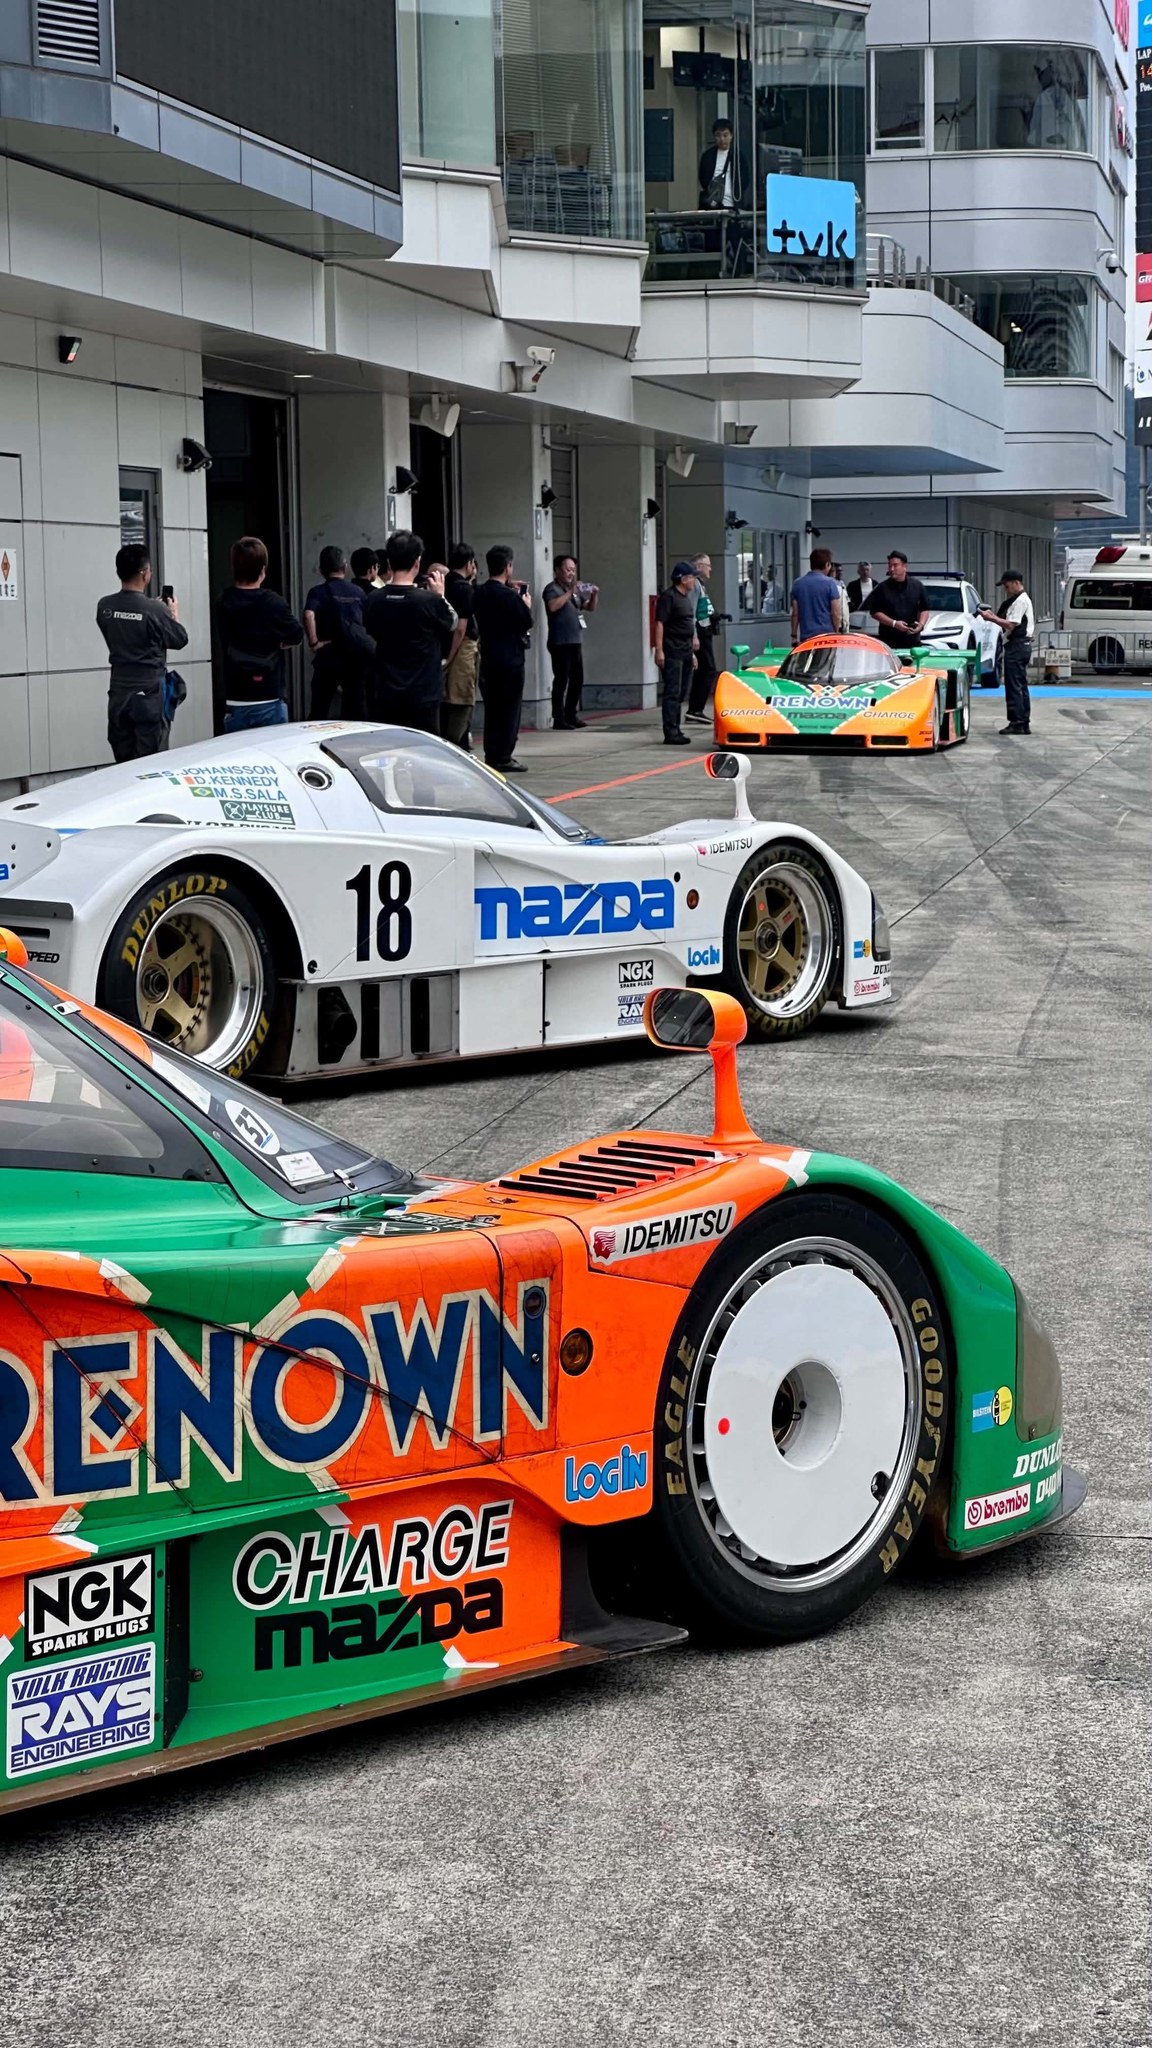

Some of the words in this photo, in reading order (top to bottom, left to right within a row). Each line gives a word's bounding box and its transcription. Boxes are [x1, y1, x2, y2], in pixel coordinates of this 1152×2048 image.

[772, 219, 848, 258] tvk
[721, 709, 773, 718] CHARGE
[770, 695, 870, 710] RENOWN
[788, 711, 848, 720] mazda
[863, 710, 916, 720] CHARGE
[162, 765, 277, 777] S.JOHANSSON
[195, 776, 279, 787] D.KENNEDY
[213, 787, 288, 801] M.S.SALA
[241, 802, 290, 814] PLAYSURE
[256, 810, 281, 820] CLUB
[710, 837, 753, 854] IDEMITSU
[121, 874, 228, 971] DUNLOP
[345, 860, 412, 962] 18
[474, 879, 675, 940] mazda
[619, 961, 653, 982] NGK
[623, 1206, 732, 1255] IDEMITSU
[665, 1335, 695, 1495] EAGLE
[984, 1490, 1029, 1520] brembo
[233, 1500, 514, 1610] CHARGE
[33, 1558, 148, 1636] NGK
[32, 1630, 89, 1657] SPARK
[94, 1616, 149, 1642] PLUGS
[254, 1577, 503, 1672] mazda
[12, 1671, 68, 1701] VOLK
[70, 1652, 151, 1689] RACING
[11, 1676, 151, 1746] RAYS
[11, 1720, 150, 1768] ENGINEERING
